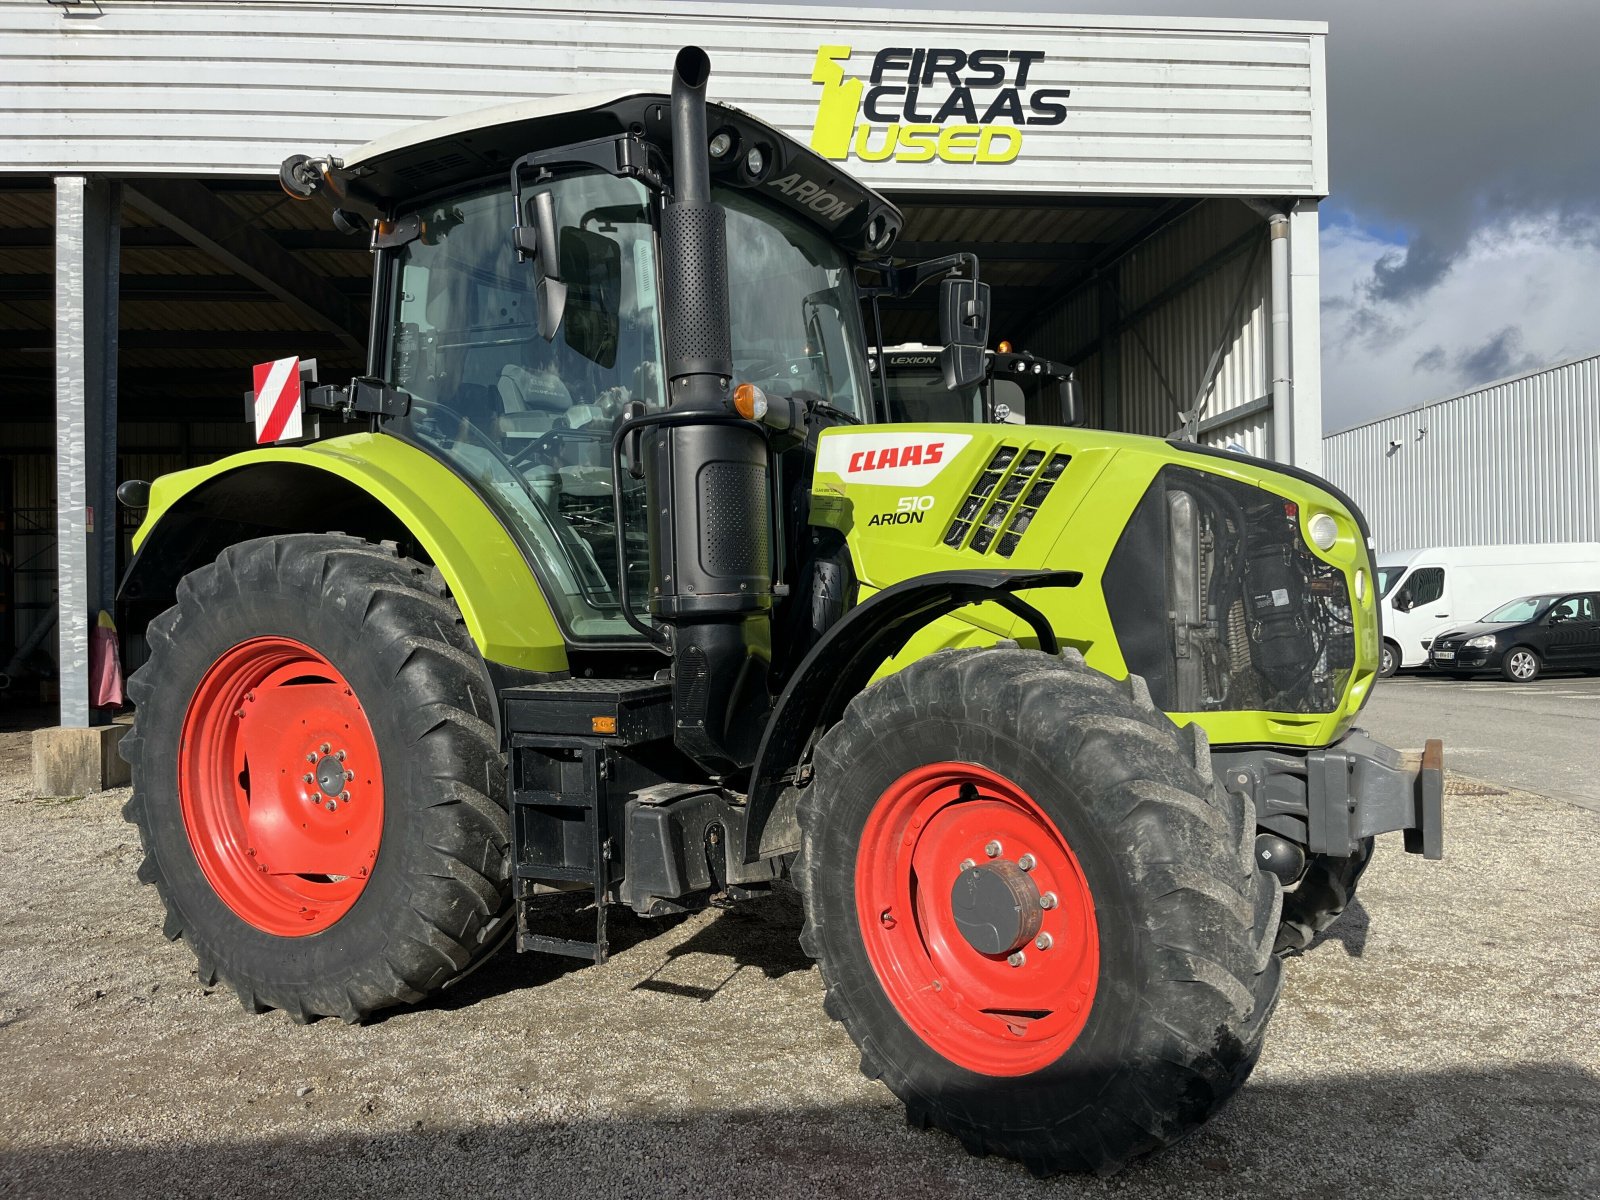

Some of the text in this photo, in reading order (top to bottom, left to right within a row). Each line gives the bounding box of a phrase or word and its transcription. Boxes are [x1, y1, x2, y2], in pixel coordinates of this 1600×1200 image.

[869, 47, 1045, 87] FIRST
[863, 86, 1071, 126] CLAAS
[855, 123, 1023, 163] USED
[767, 172, 854, 222] ARION
[890, 356, 936, 365] LEXION
[848, 442, 945, 473] CLAAS
[868, 511, 925, 527] ARION
[896, 495, 935, 513] 510
